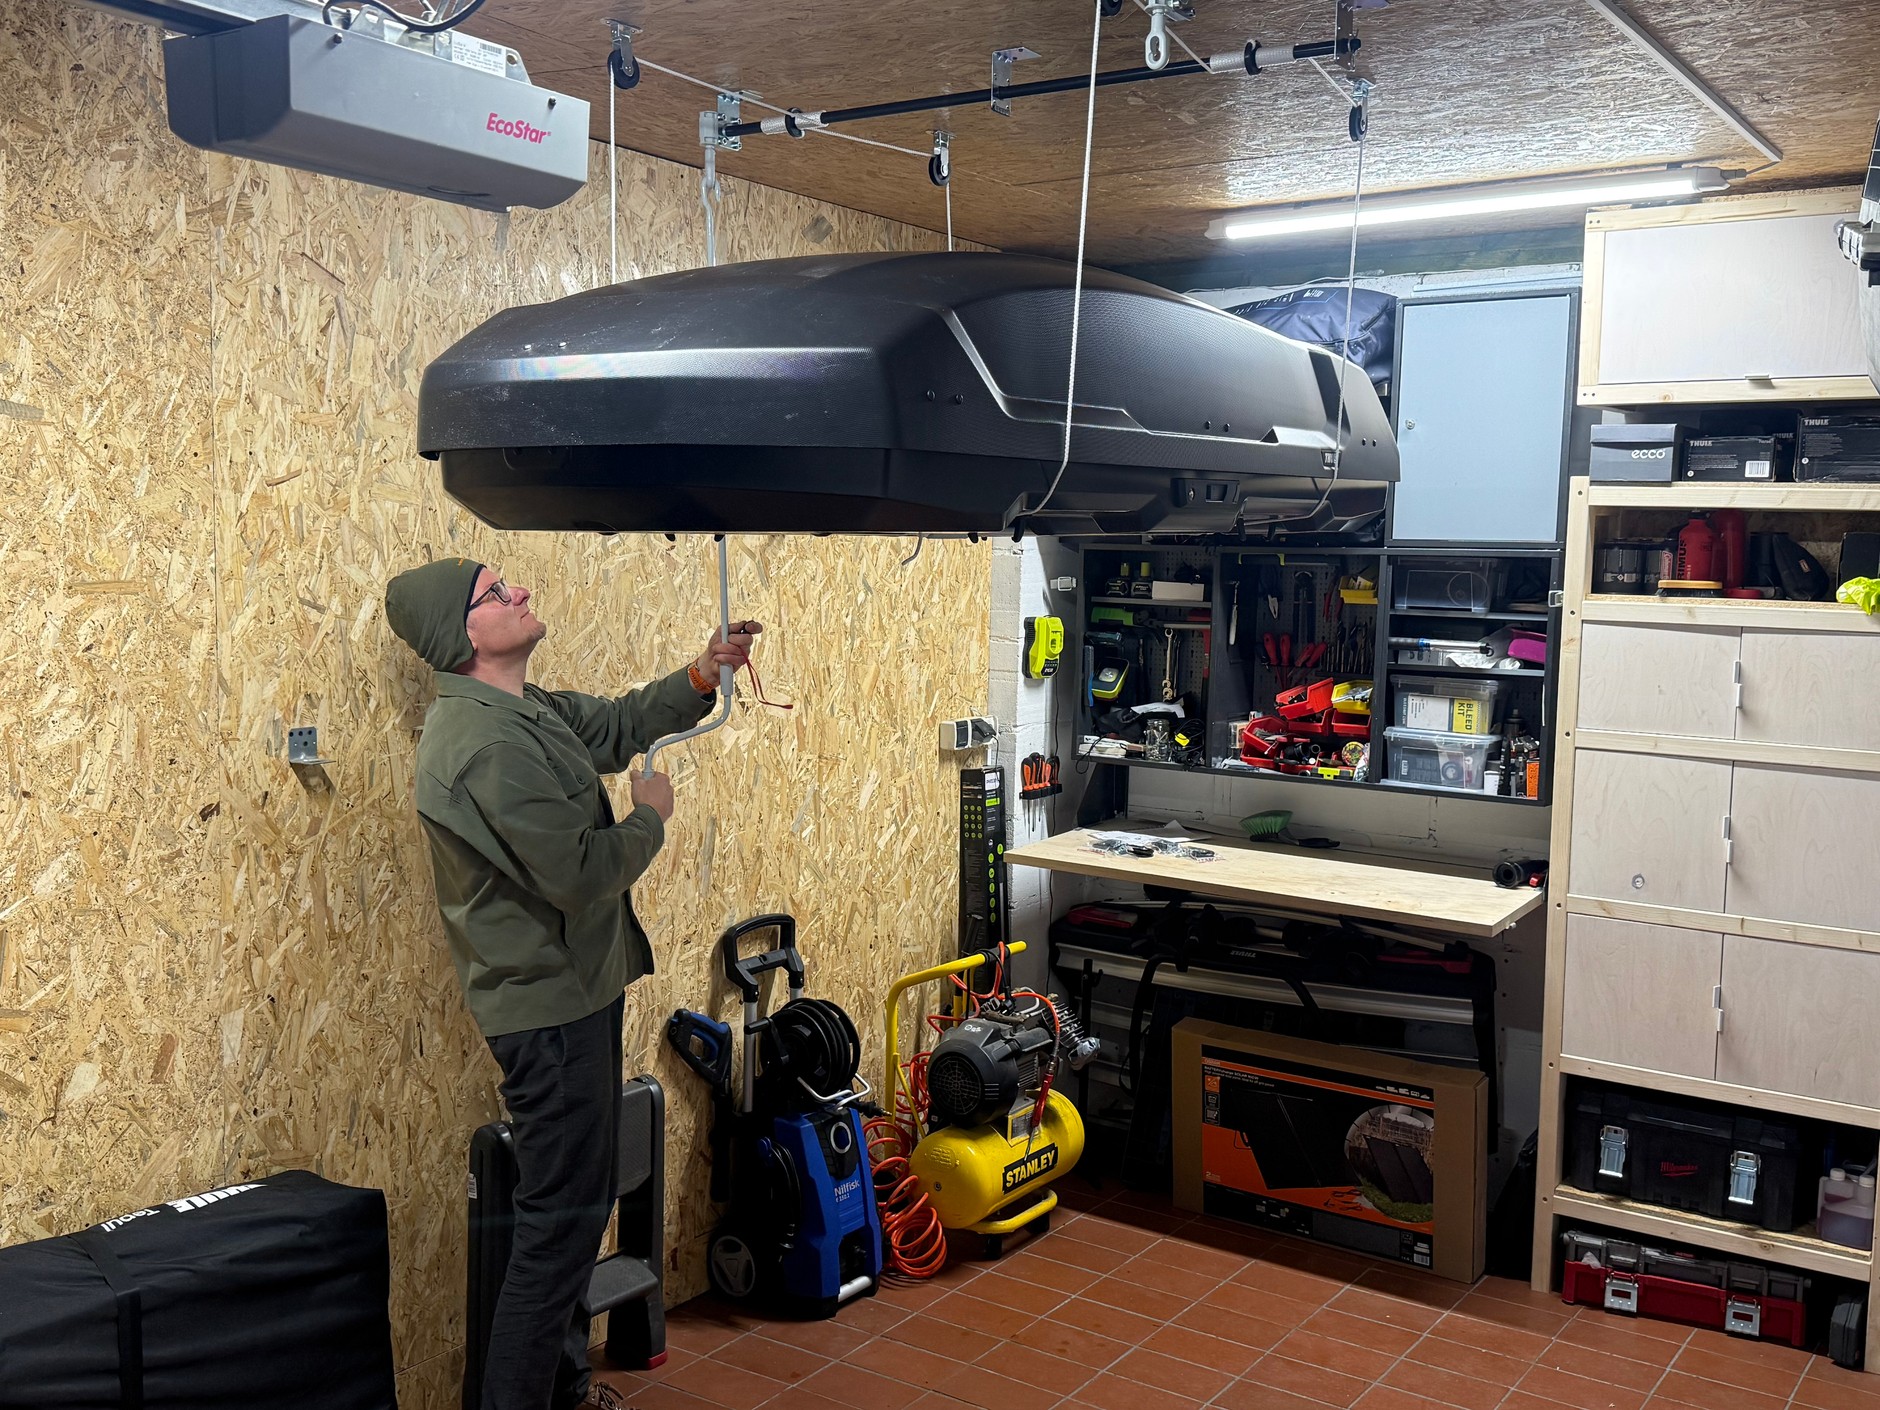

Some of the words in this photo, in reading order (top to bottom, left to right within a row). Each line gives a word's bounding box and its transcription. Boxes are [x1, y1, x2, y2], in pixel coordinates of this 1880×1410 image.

[1804, 418, 1831, 426] THULE
[1631, 448, 1665, 459] ecco
[1677, 539, 1687, 580] RIMUS
[1457, 702, 1466, 717] KIT
[1465, 702, 1474, 730] BLEED
[1006, 1150, 1056, 1187] STANLEY
[834, 1179, 860, 1197] Nilfisk
